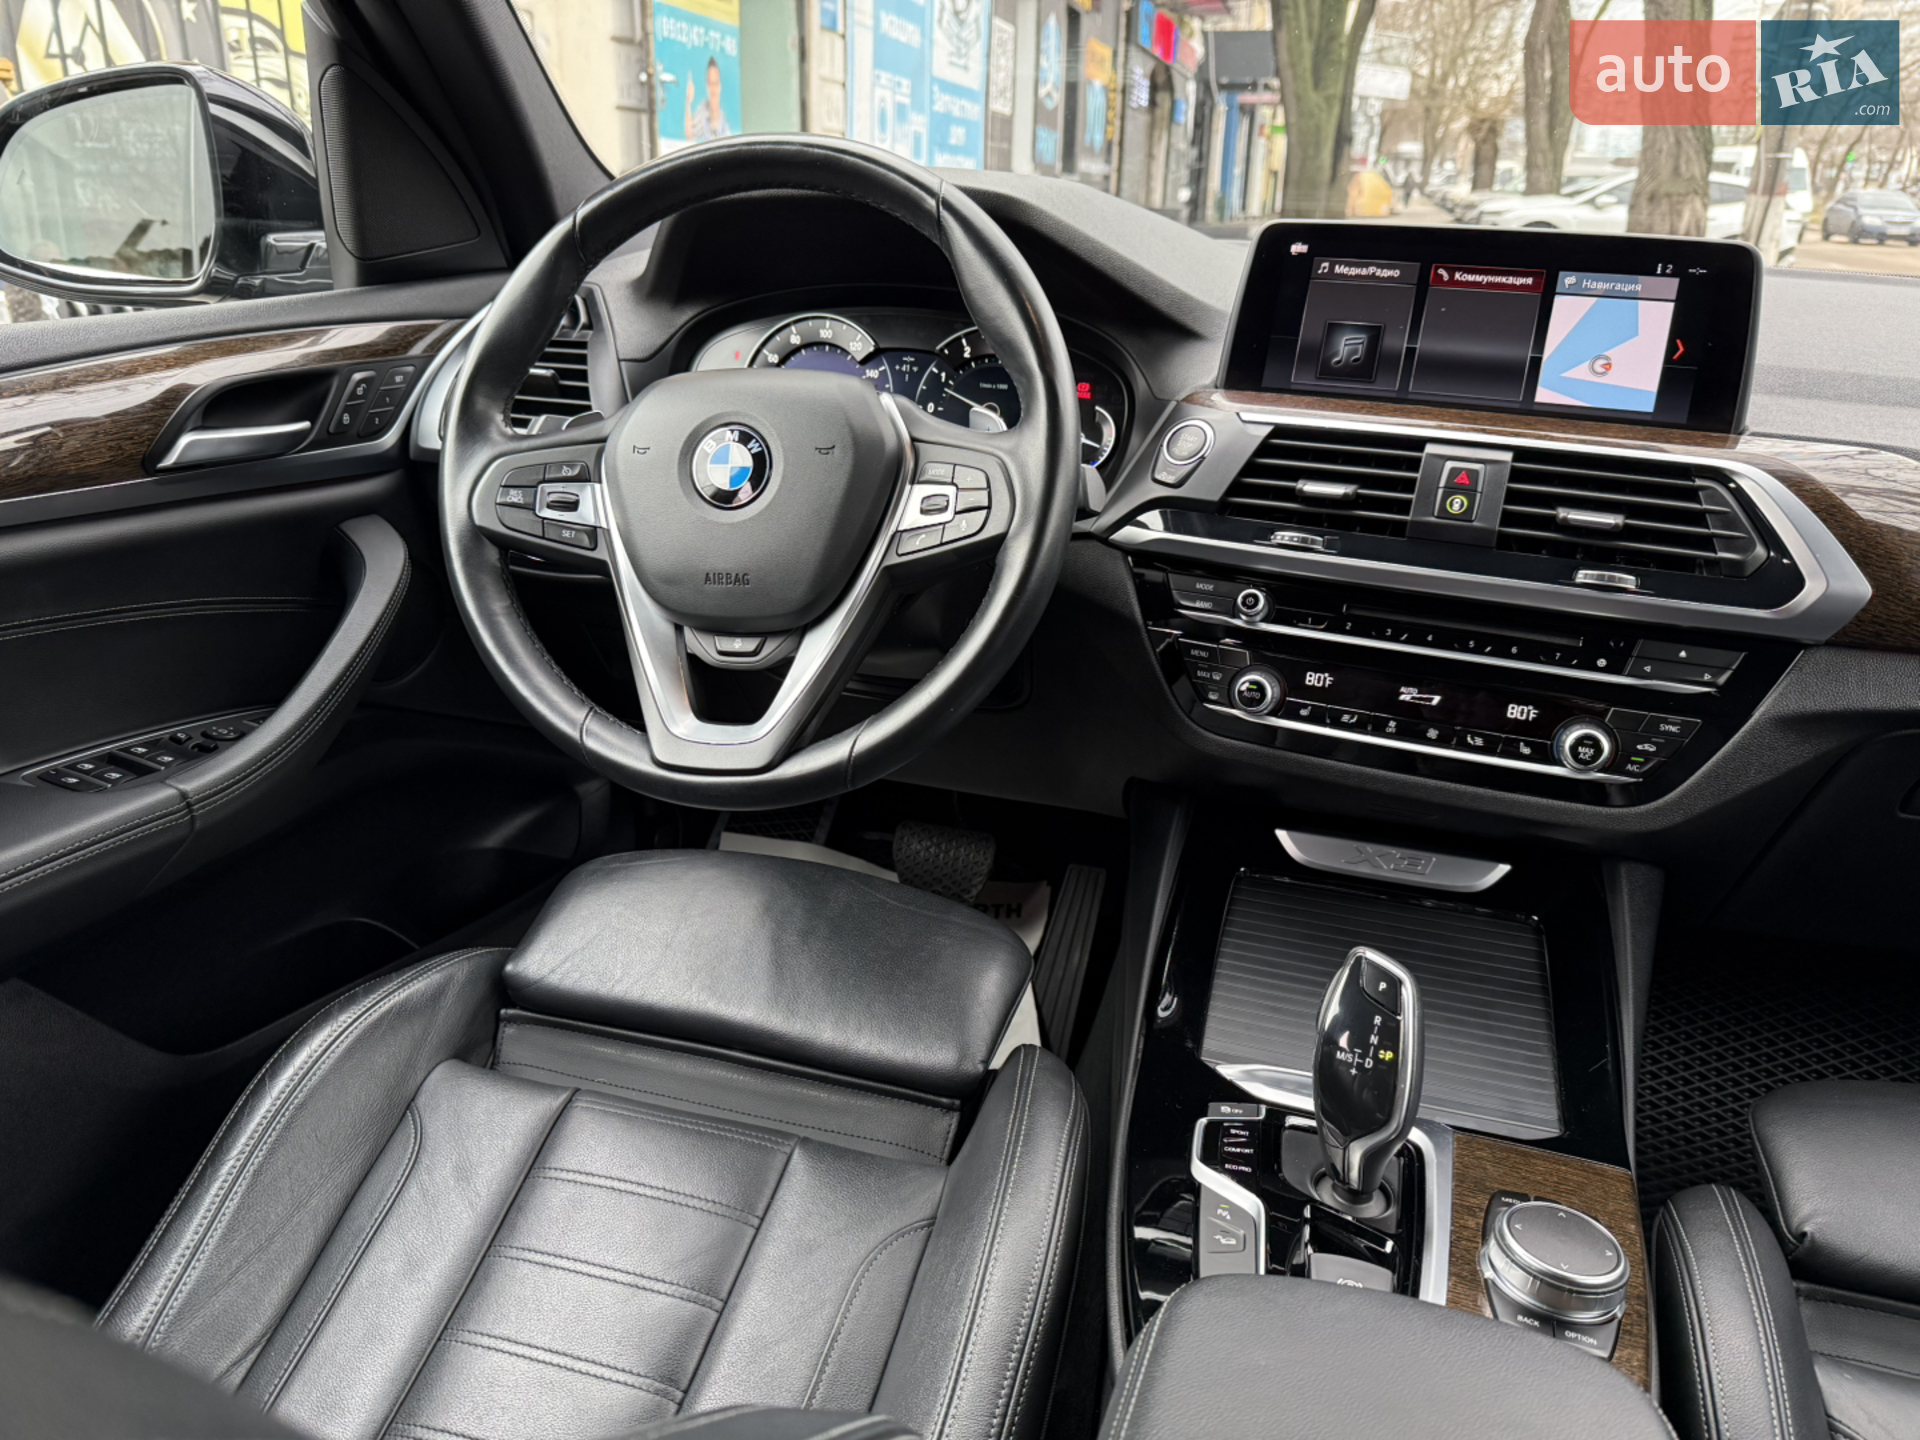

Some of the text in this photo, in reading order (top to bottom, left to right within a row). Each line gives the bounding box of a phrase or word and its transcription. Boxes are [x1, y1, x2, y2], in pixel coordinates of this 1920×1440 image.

[1334, 264, 1401, 278] Медиа/Радио
[1453, 271, 1534, 287] Коммуникация
[1581, 279, 1643, 293] Навигация
[819, 329, 832, 340] 100
[790, 335, 800, 345] 80
[849, 342, 863, 351] 120
[963, 346, 971, 358] 2
[767, 354, 779, 364] 60
[865, 369, 879, 379] 140
[940, 372, 947, 382] 1
[926, 402, 935, 413] 0
[703, 430, 762, 454] BMW
[562, 530, 576, 538] SET
[704, 572, 750, 587] AIRBAG
[1196, 583, 1215, 592] MODE
[1307, 617, 1312, 625] 1
[1345, 622, 1352, 630] 2
[1385, 628, 1392, 636] 3
[1426, 633, 1433, 641] 4
[1468, 640, 1475, 648] 5
[1190, 649, 1209, 659] MENU
[1511, 646, 1518, 654] 6
[1555, 652, 1561, 660] 7
[1197, 670, 1211, 680] MAX
[1243, 689, 1261, 700] AUTO
[1659, 723, 1681, 734] SYNC
[1577, 746, 1595, 756] MAX
[1625, 763, 1641, 772] A/C
[1378, 981, 1387, 991] P
[1373, 1015, 1382, 1026] R
[1369, 1034, 1379, 1045] N
[1336, 1050, 1353, 1063] M/S
[1364, 1058, 1373, 1069] D
[1229, 1128, 1250, 1137] SPORT
[1223, 1145, 1254, 1154] COMFORT
[1224, 1163, 1253, 1173] ECO PRO
[1516, 1314, 1541, 1328] BACK
[1564, 1330, 1598, 1346] OPTION
